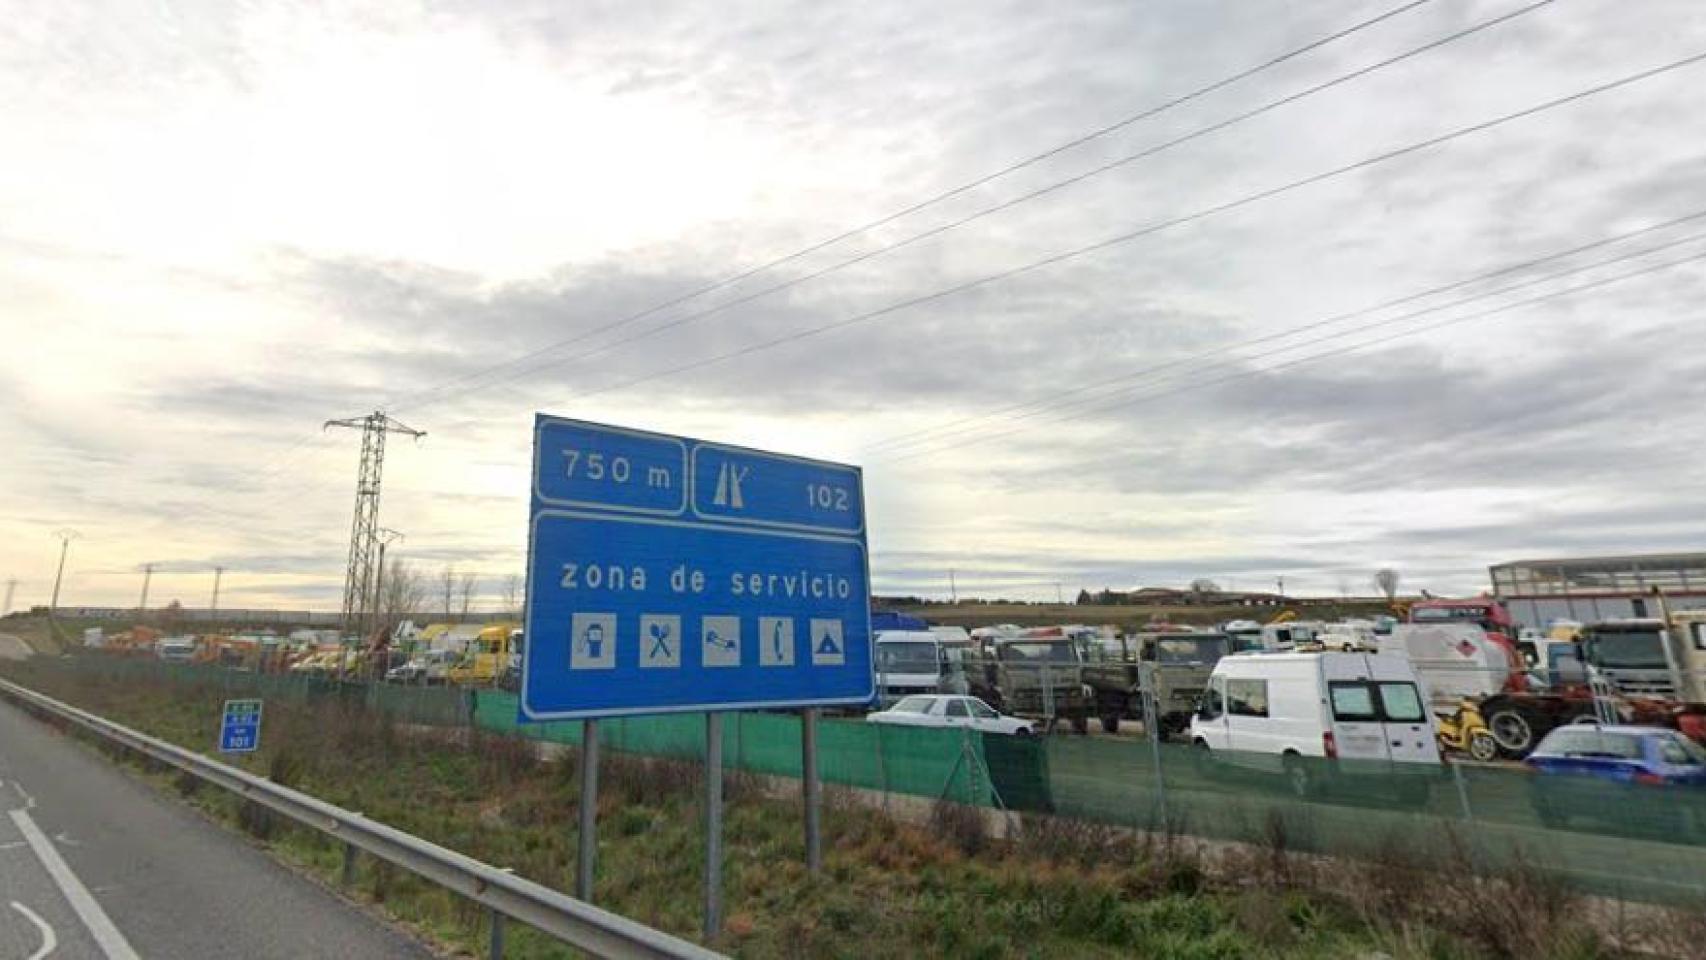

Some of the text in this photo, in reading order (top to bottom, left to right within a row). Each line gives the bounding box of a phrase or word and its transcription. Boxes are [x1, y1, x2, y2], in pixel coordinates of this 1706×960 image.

[561, 450, 670, 488] 750 m
[806, 484, 849, 511] 102
[561, 563, 849, 598] zona de servicio
